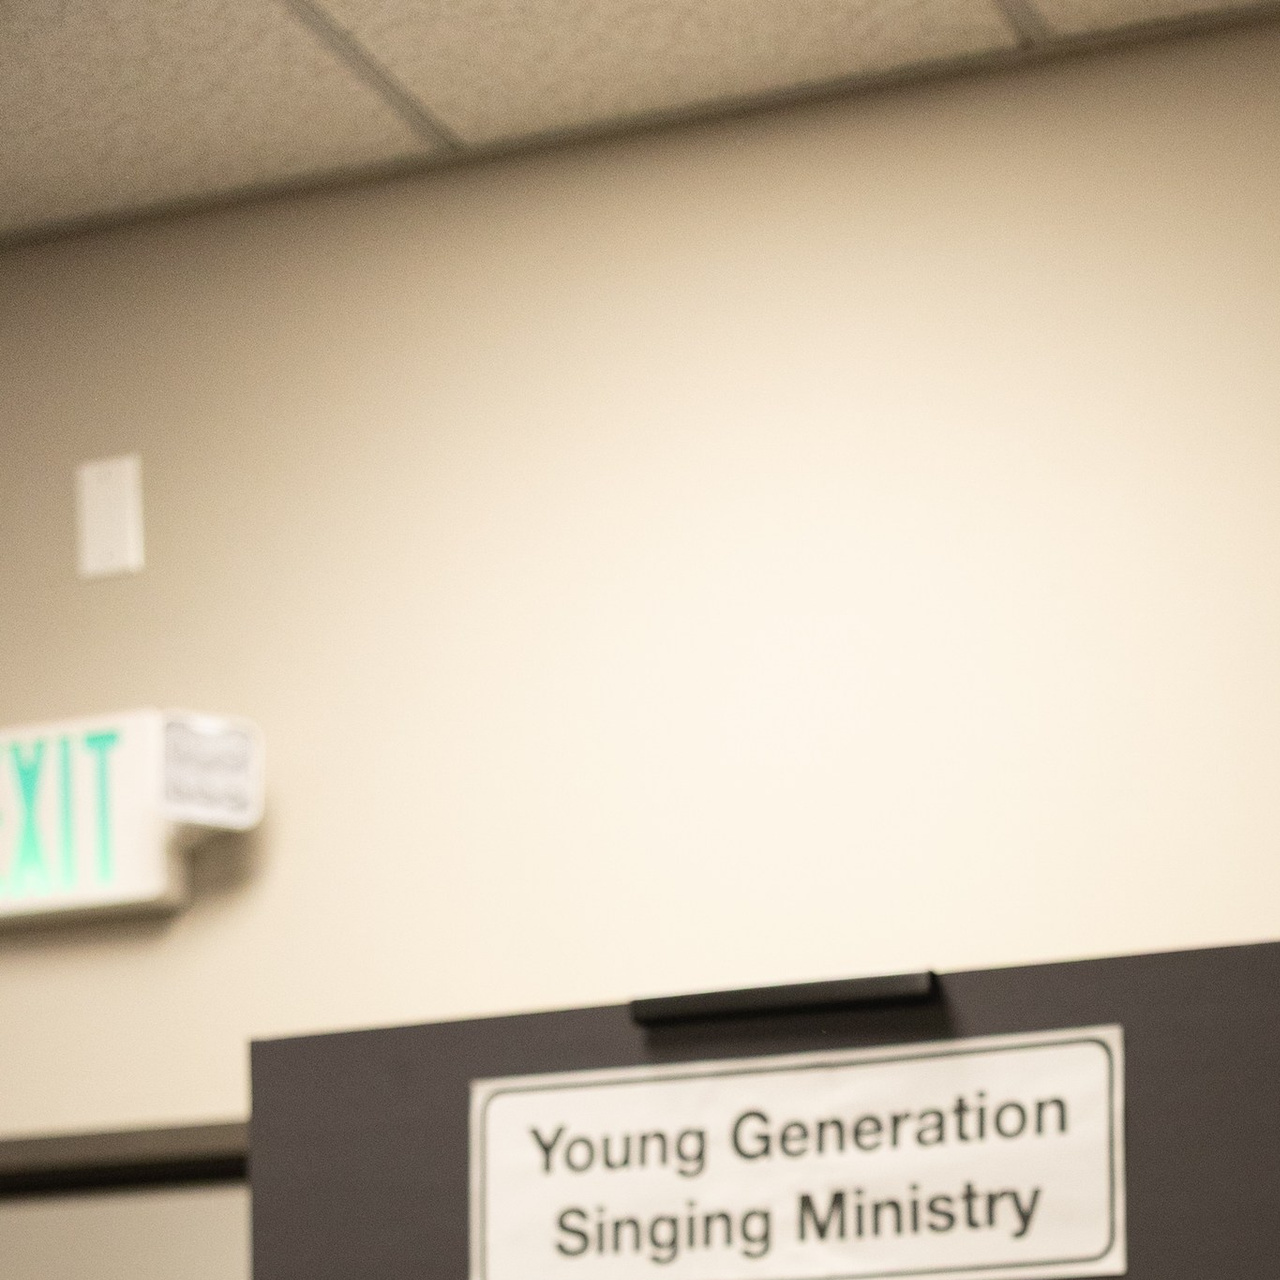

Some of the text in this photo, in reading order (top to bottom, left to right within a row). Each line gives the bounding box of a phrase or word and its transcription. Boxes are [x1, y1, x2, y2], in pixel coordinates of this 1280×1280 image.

[0, 731, 120, 894] XIT
[530, 1091, 1069, 1177] Young Generation
[555, 1182, 1043, 1263] Singing Ministry
